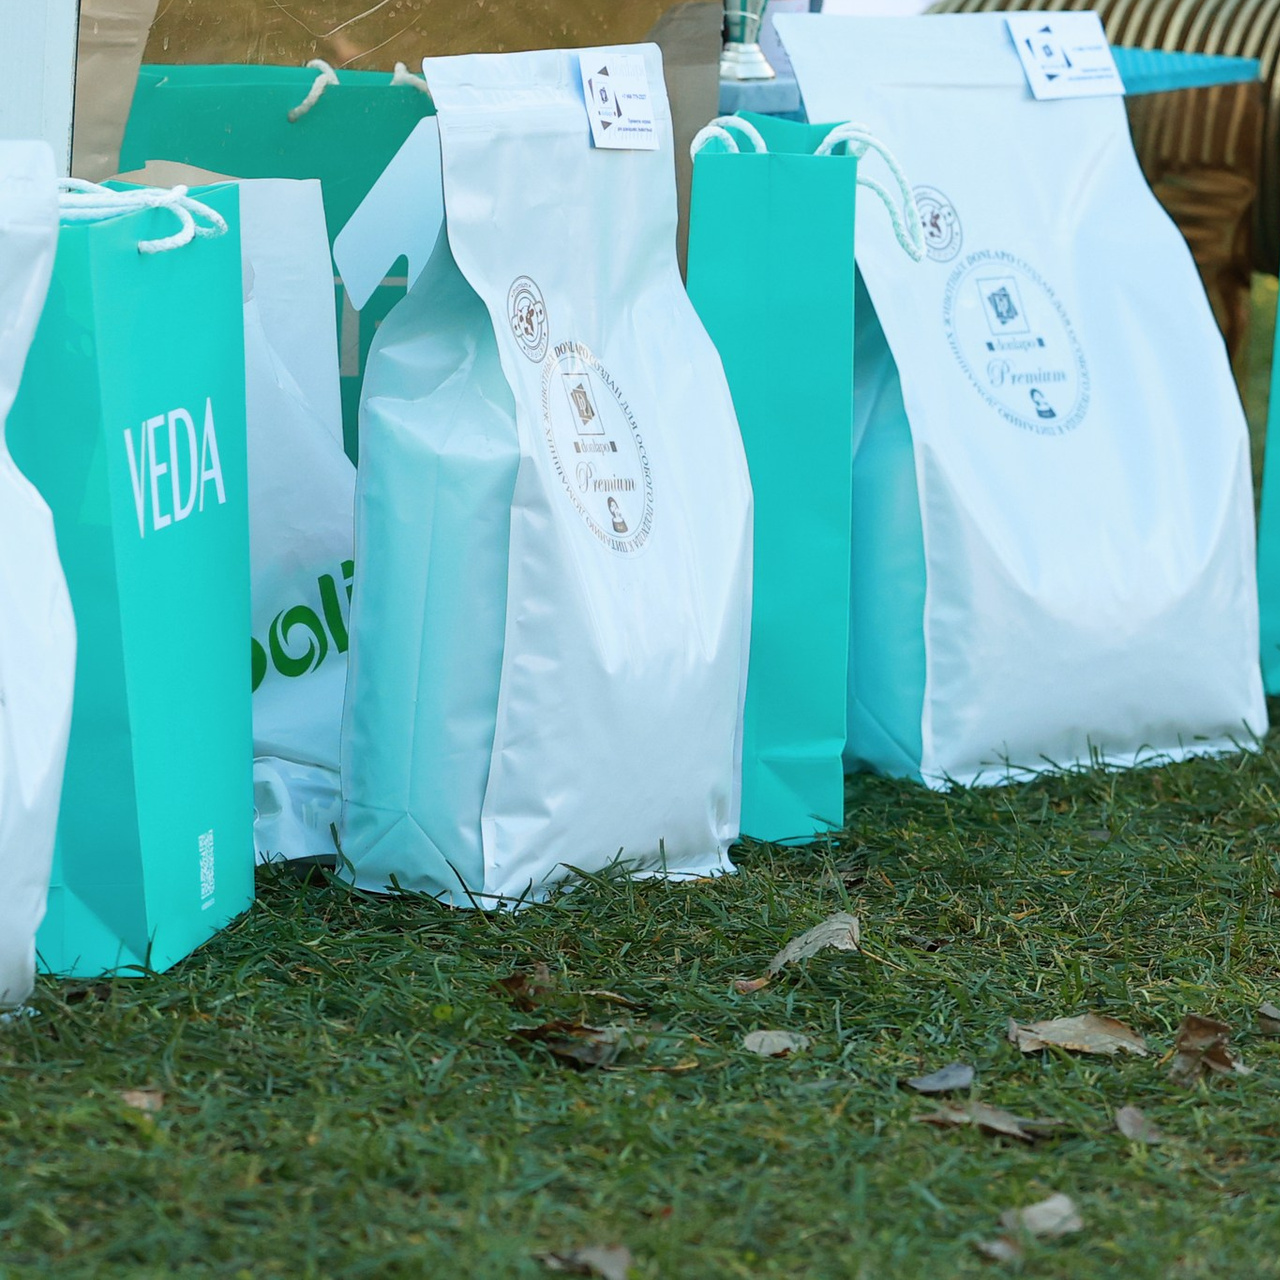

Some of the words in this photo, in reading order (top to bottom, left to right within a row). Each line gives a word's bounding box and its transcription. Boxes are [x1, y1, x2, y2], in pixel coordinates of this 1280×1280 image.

[986, 357, 1067, 388] Premium
[123, 397, 227, 539] VEDA
[575, 460, 636, 494] Premium
